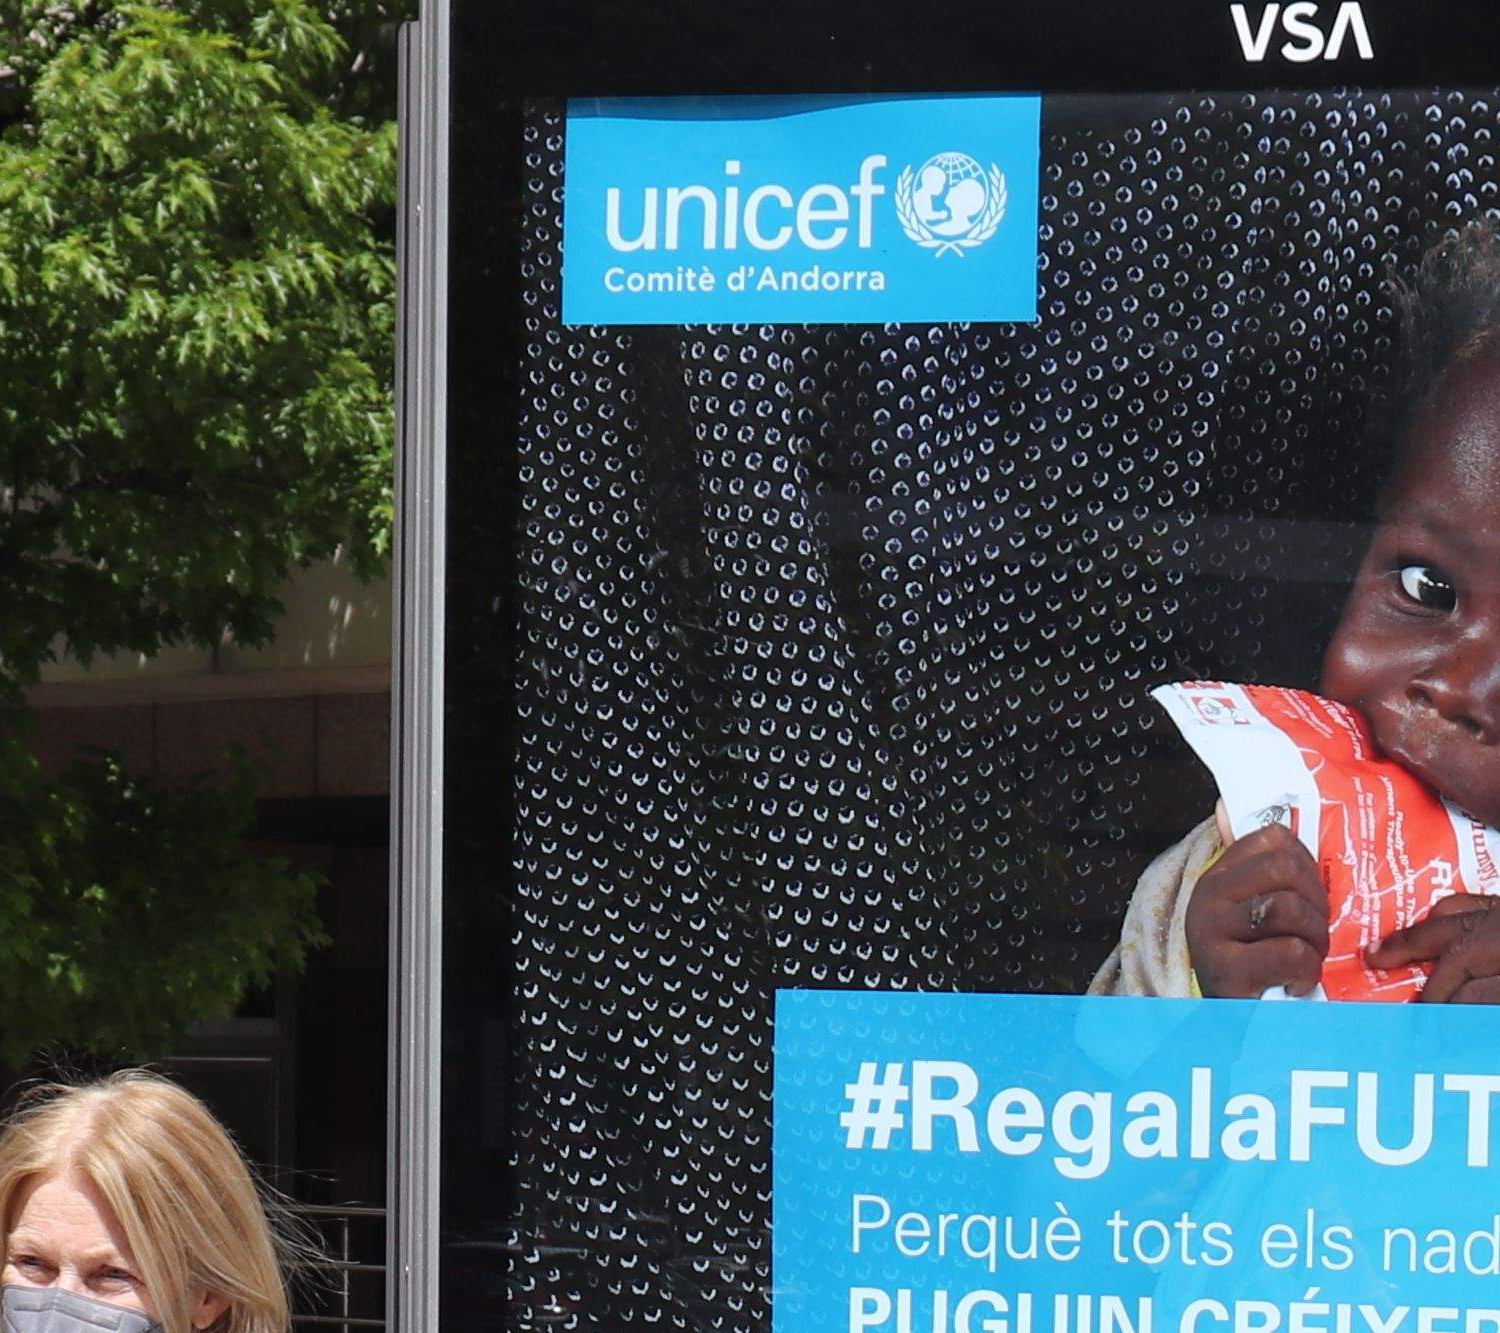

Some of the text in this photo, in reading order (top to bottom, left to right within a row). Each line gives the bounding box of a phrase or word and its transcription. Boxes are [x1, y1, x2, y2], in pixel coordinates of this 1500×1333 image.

[604, 154, 887, 254] unicef
[603, 264, 716, 296] Comitè
[851, 1193, 1082, 1272] Perquè
[1107, 1207, 1235, 1269] tots
[1261, 1208, 1355, 1272] els
